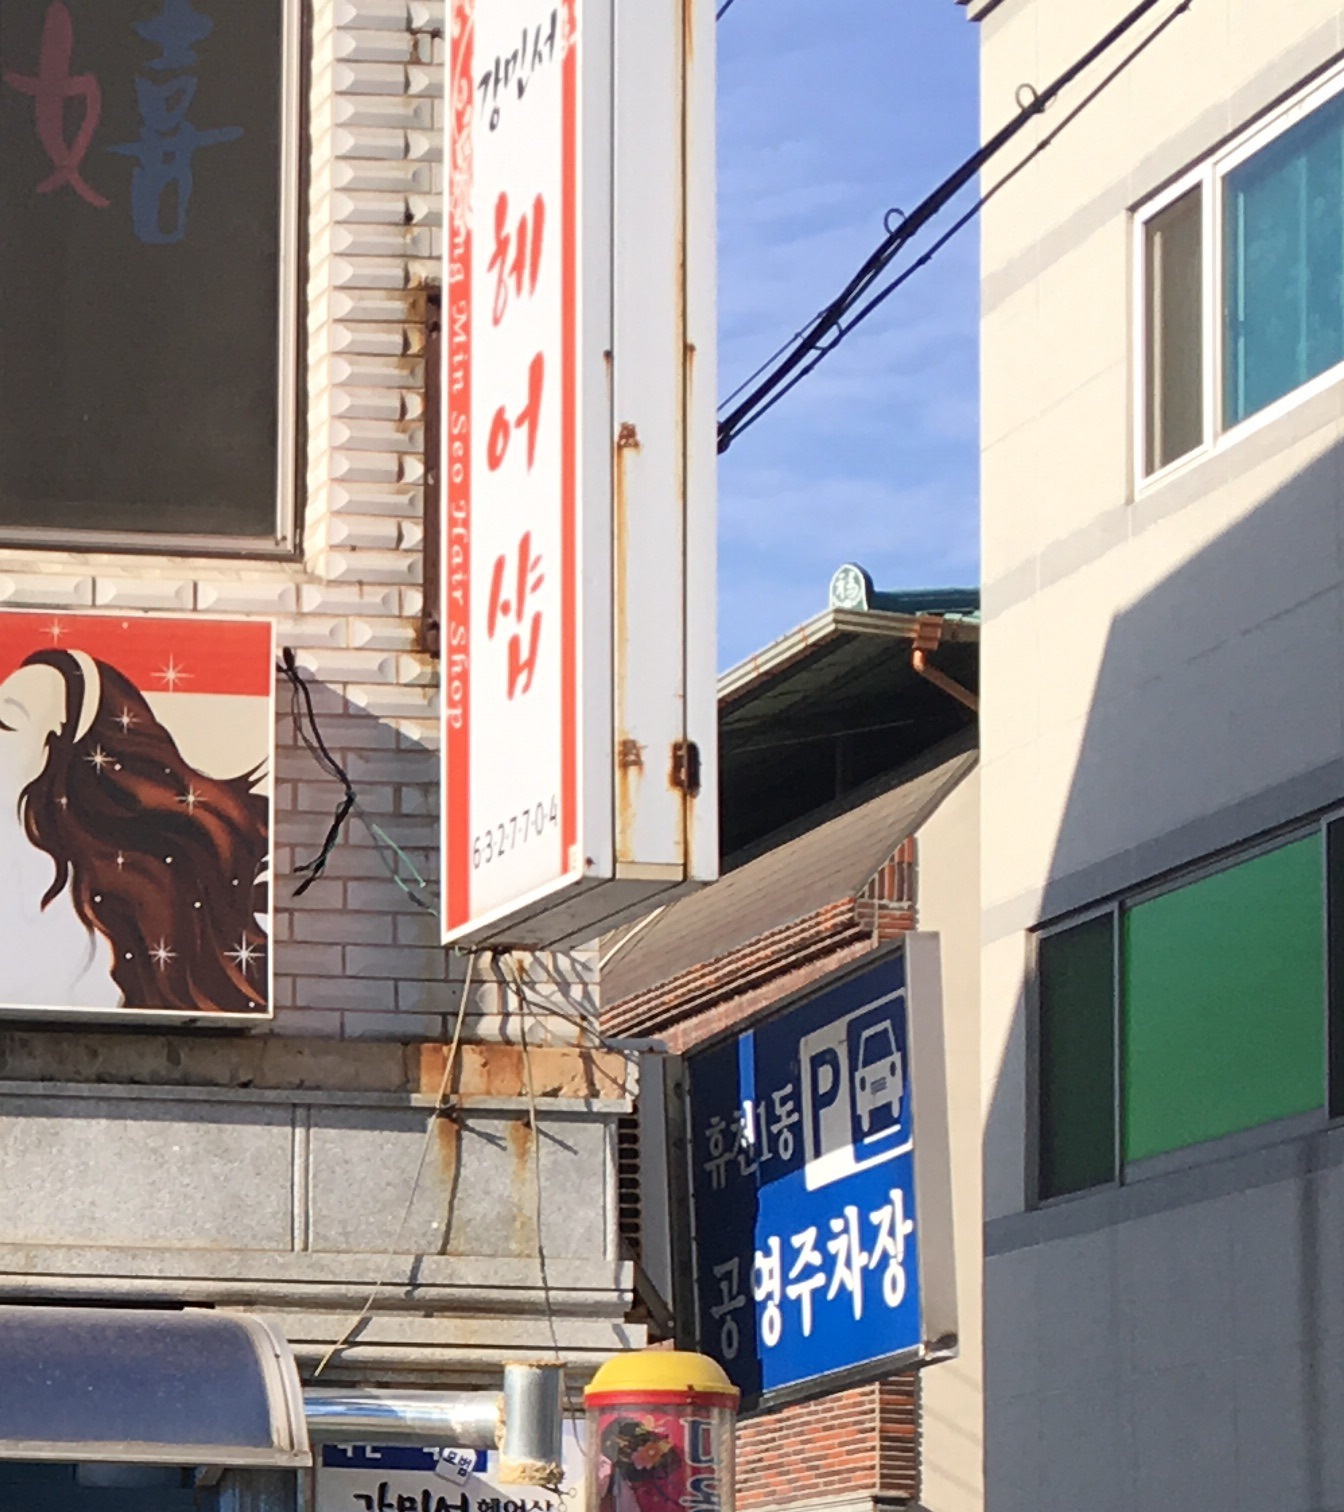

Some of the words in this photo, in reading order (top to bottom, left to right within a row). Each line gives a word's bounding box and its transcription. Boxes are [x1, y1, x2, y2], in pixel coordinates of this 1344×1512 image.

[478, 8, 557, 132] 강민서
[452, 300, 468, 393] Min
[451, 411, 468, 483] Seo
[450, 500, 470, 602] Hair
[446, 623, 469, 729] Shop
[703, 1082, 800, 1190] 휴천1동
[712, 1187, 914, 1361] 공영주차장
[443, 1451, 473, 1478] 모범
